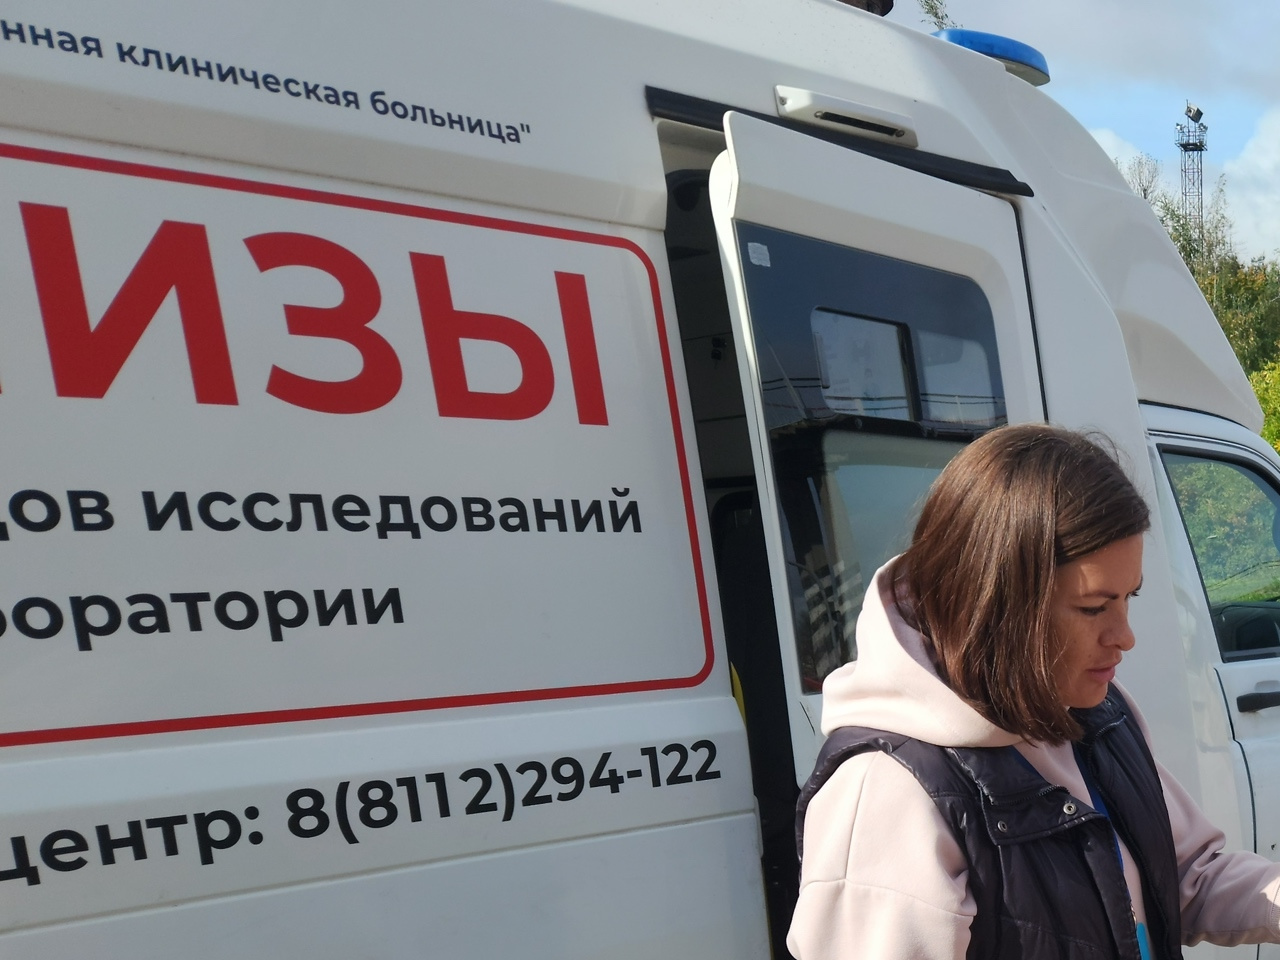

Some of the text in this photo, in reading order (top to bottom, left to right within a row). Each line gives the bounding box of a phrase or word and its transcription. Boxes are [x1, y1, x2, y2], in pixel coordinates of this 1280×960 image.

[116, 42, 361, 111] клиническая
[370, 90, 531, 145] больница"
[0, 486, 643, 542] ов исследований
[286, 738, 722, 845] 8(8112)294-122
